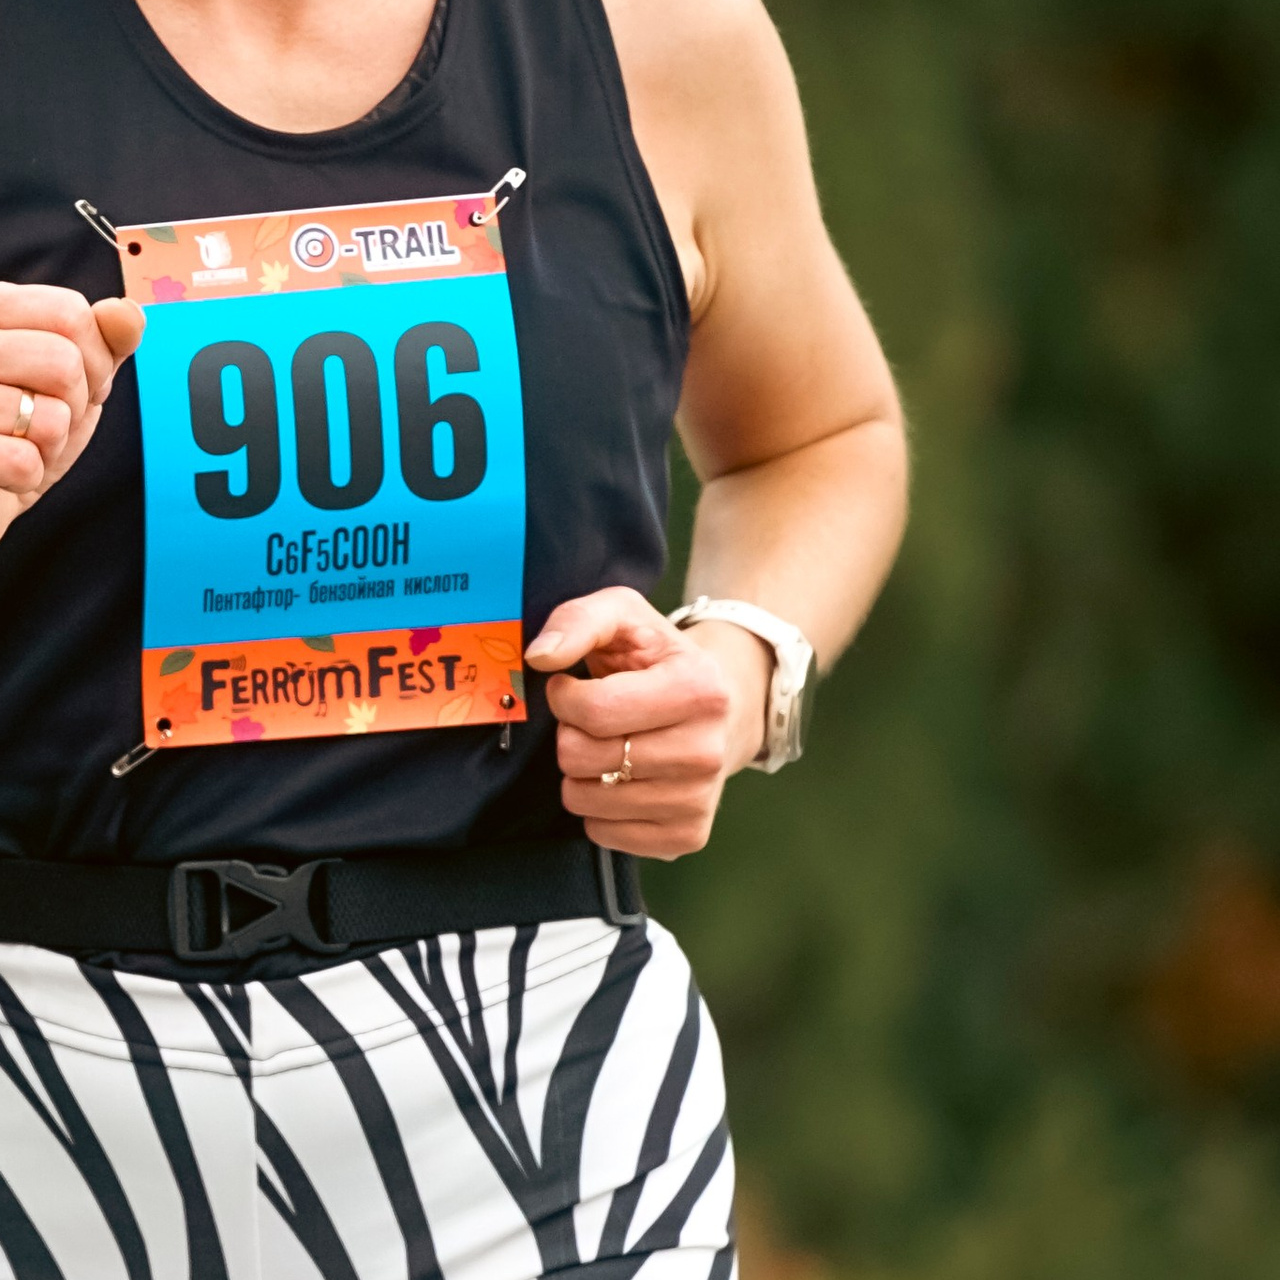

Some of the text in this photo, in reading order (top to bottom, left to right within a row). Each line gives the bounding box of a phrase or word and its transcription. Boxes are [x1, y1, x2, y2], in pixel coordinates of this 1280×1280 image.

[187, 321, 488, 520] 906
[266, 522, 410, 576] C6F5COOH
[203, 571, 470, 614] Пентафтор- бензойная кислота
